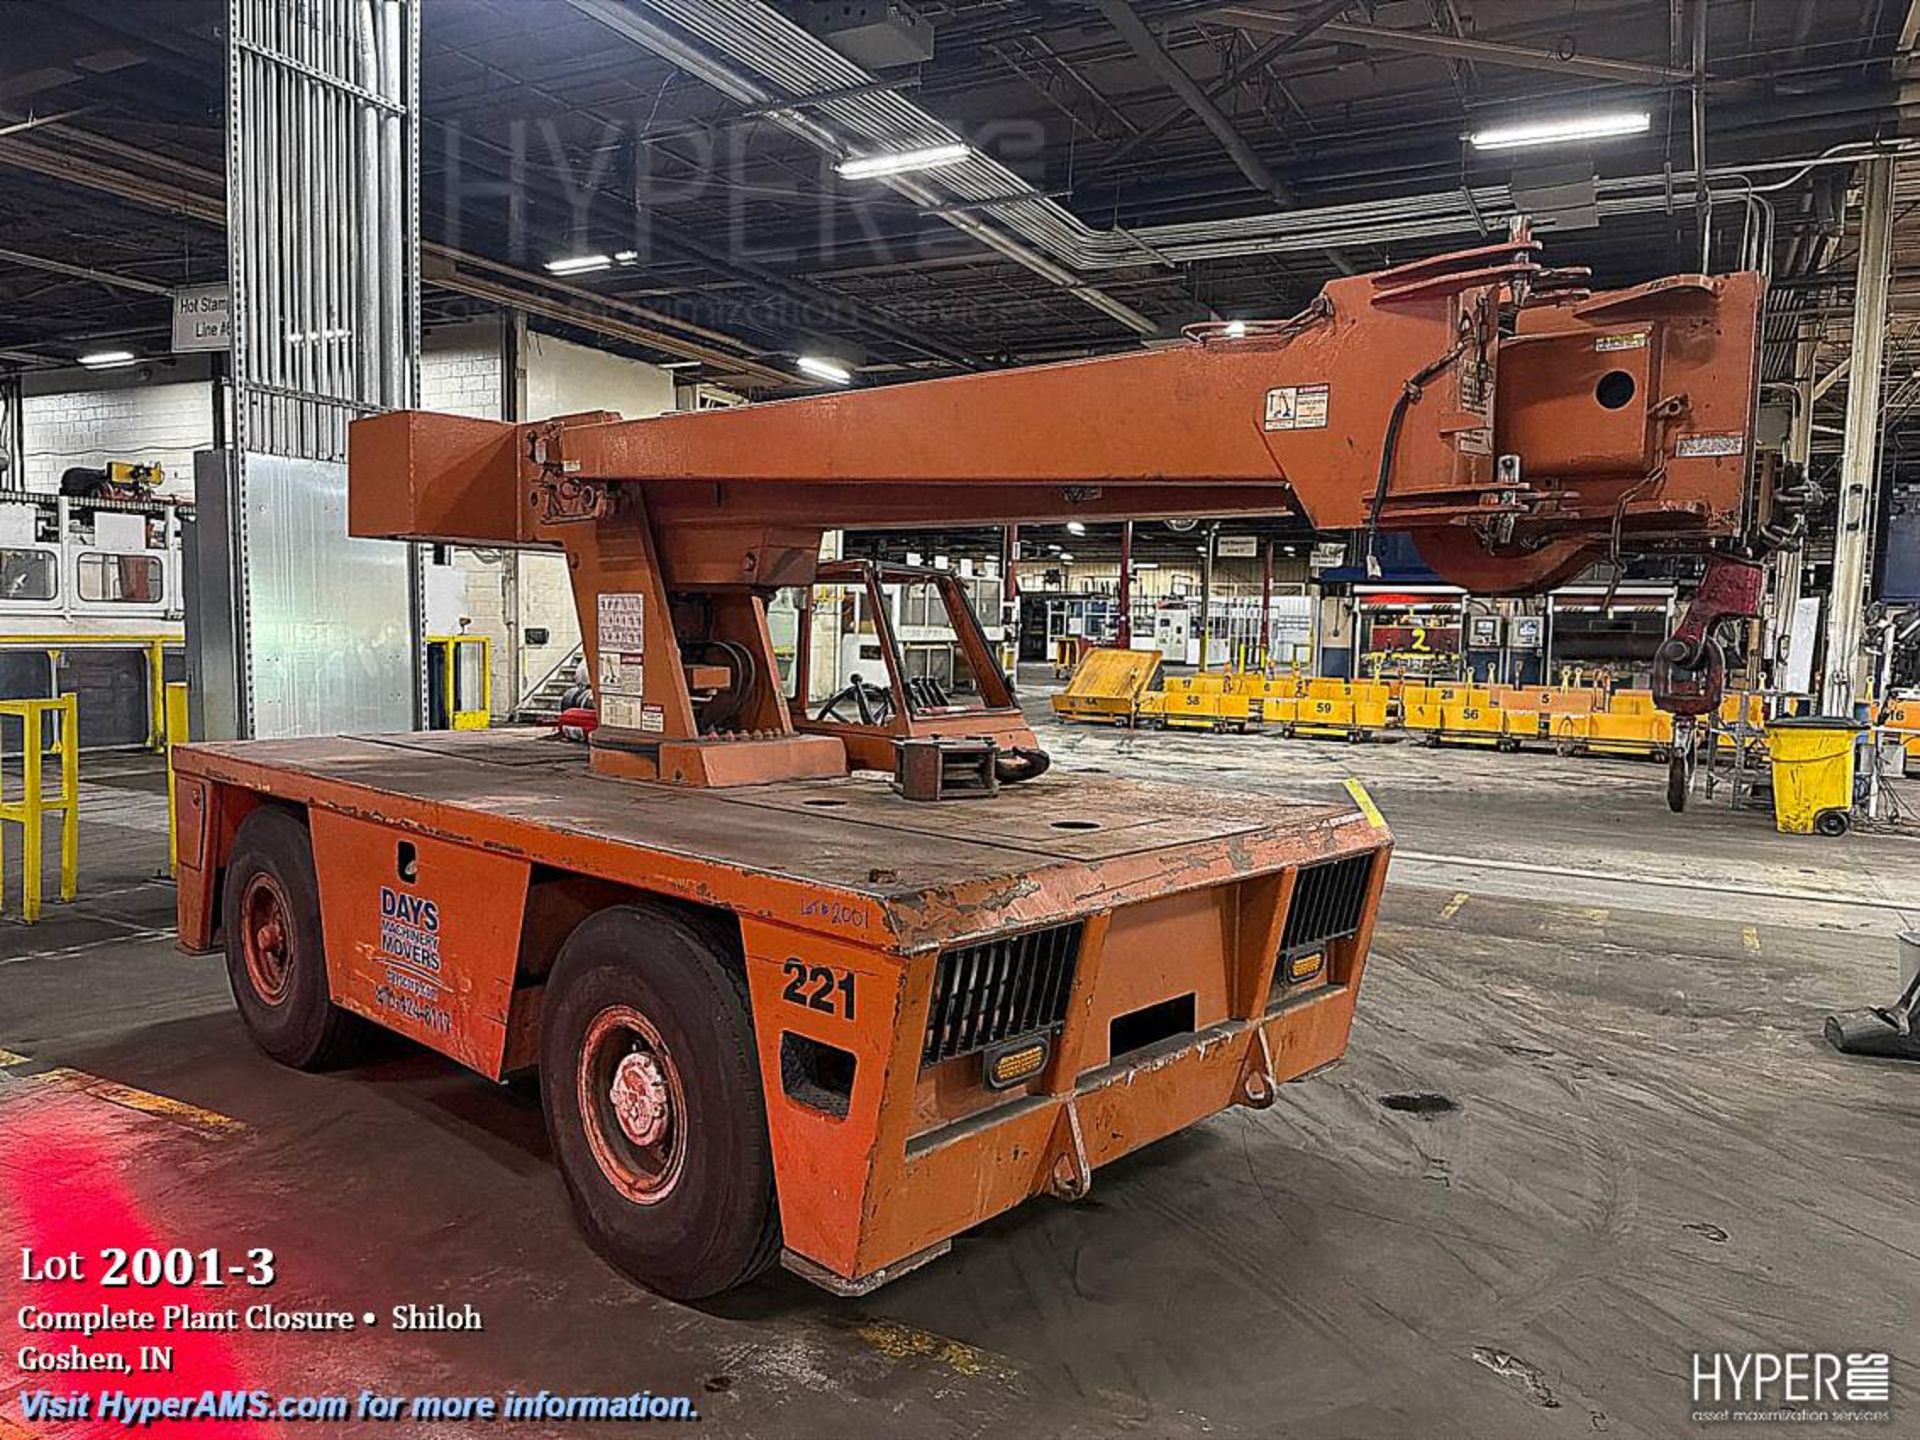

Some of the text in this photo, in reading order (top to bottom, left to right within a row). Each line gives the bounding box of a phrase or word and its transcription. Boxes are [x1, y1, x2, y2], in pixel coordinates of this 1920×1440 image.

[180, 297, 198, 314] Hot
[196, 321, 218, 337] Line
[1411, 628, 1430, 651] 2
[1316, 702, 1332, 714] 59
[1463, 708, 1480, 720] 56
[380, 886, 439, 932] DAYS
[381, 917, 439, 950] MACHINERY
[381, 933, 441, 973] MOVERS
[782, 956, 856, 1021] 221
